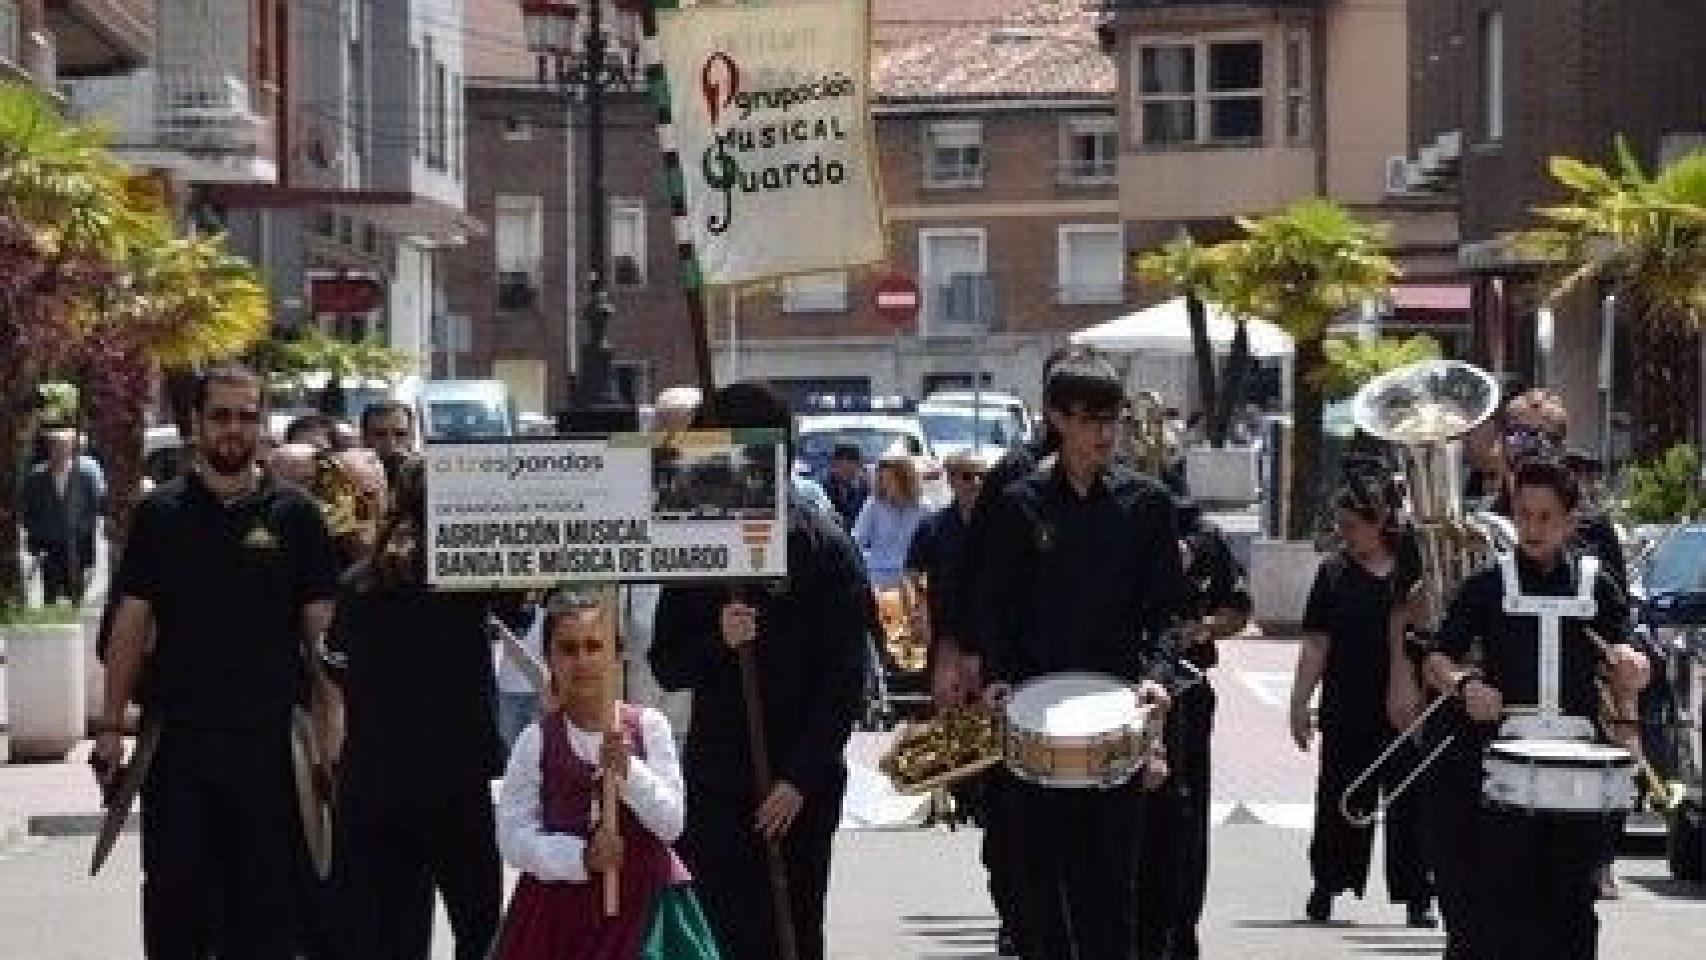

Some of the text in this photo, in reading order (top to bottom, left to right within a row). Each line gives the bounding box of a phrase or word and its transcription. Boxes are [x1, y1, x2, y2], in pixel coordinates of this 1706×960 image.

[435, 517, 650, 548] AGRUPACIÓN MUSICAL
[435, 546, 729, 576] BANDA DE MÚSICA DE GUARDO
